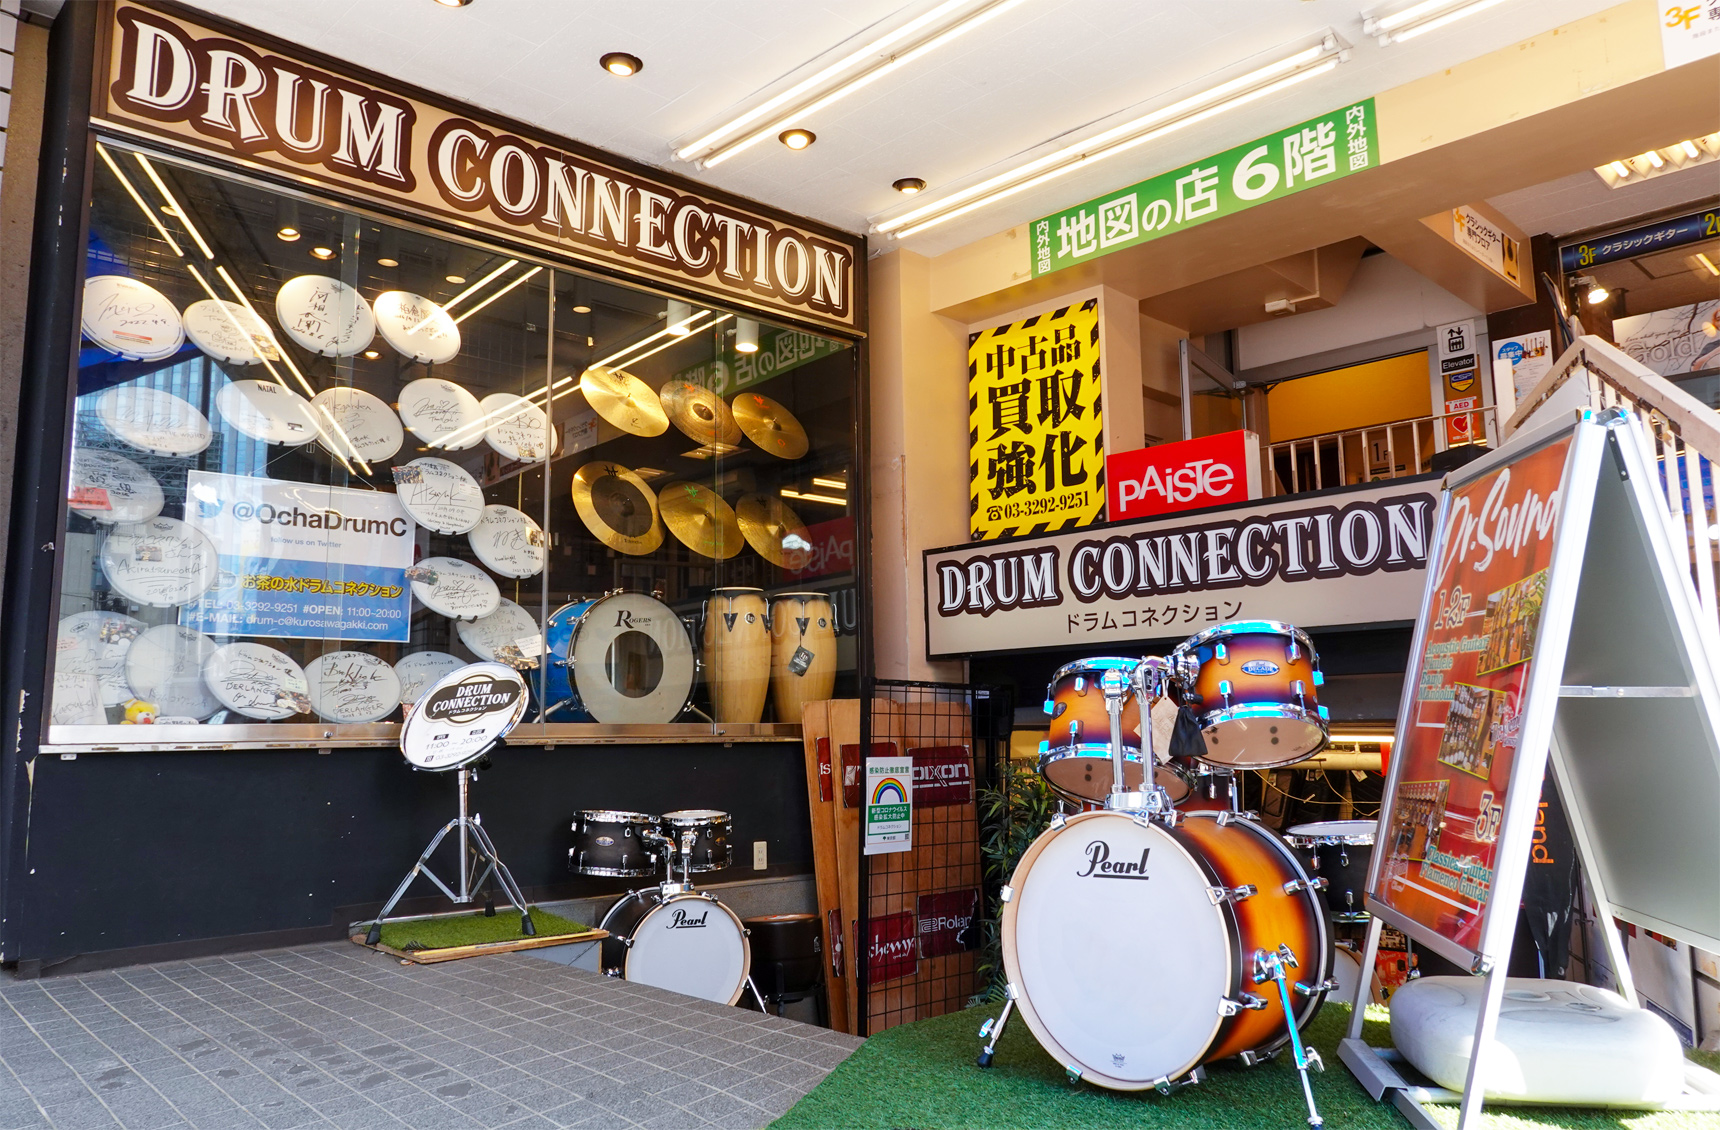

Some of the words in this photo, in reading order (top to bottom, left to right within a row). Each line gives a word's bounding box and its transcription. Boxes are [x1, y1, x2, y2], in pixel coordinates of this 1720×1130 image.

[1665, 5, 1701, 30] 3F
[1346, 106, 1369, 172] 内外地図
[126, 19, 406, 182] DRUM
[438, 128, 846, 310] CONNECTION
[1057, 165, 1220, 259] 地図の店
[1232, 121, 1336, 201] 6階
[1036, 220, 1051, 274] 内外地図
[1579, 245, 1597, 266] 3F
[1602, 228, 1689, 255] クラシックギター
[986, 324, 1081, 380] 中古品
[1443, 356, 1474, 370] Elevator
[1625, 333, 1699, 365] Gold
[257, 384, 277, 394] NATAL
[986, 369, 1086, 442] 買取
[1453, 401, 1470, 410] AED
[987, 431, 1088, 500] 強化
[232, 501, 407, 537] @OchaDrumC
[1004, 490, 1089, 519] 03-3292-9251
[318, 540, 342, 548] Twitter
[941, 552, 1059, 613] DRUM
[1072, 501, 1429, 596] CONNECTION
[241, 574, 403, 599] お茶の水ドラムコネクション
[226, 600, 298, 613] 03-3292-9251
[303, 604, 343, 616] #OPEN:
[246, 614, 388, 631] drum-c@kurosawagakki.com
[1066, 600, 1243, 634] ドラムコネクション
[1434, 585, 1472, 630] 1-2F
[1426, 637, 1460, 655] Acoustic
[1459, 635, 1490, 652] Guitar
[433, 692, 511, 713] CONNECTION
[456, 683, 493, 698] DRUM
[426, 741, 450, 751] 11:00
[461, 736, 488, 746] 20:00
[1475, 790, 1503, 842] 3F
[1077, 840, 1151, 877] Pearl
[1419, 860, 1459, 892] Flamenco
[1457, 874, 1490, 903] Guitar
[666, 909, 709, 930] Pearl
[938, 914, 972, 931] Rolan
